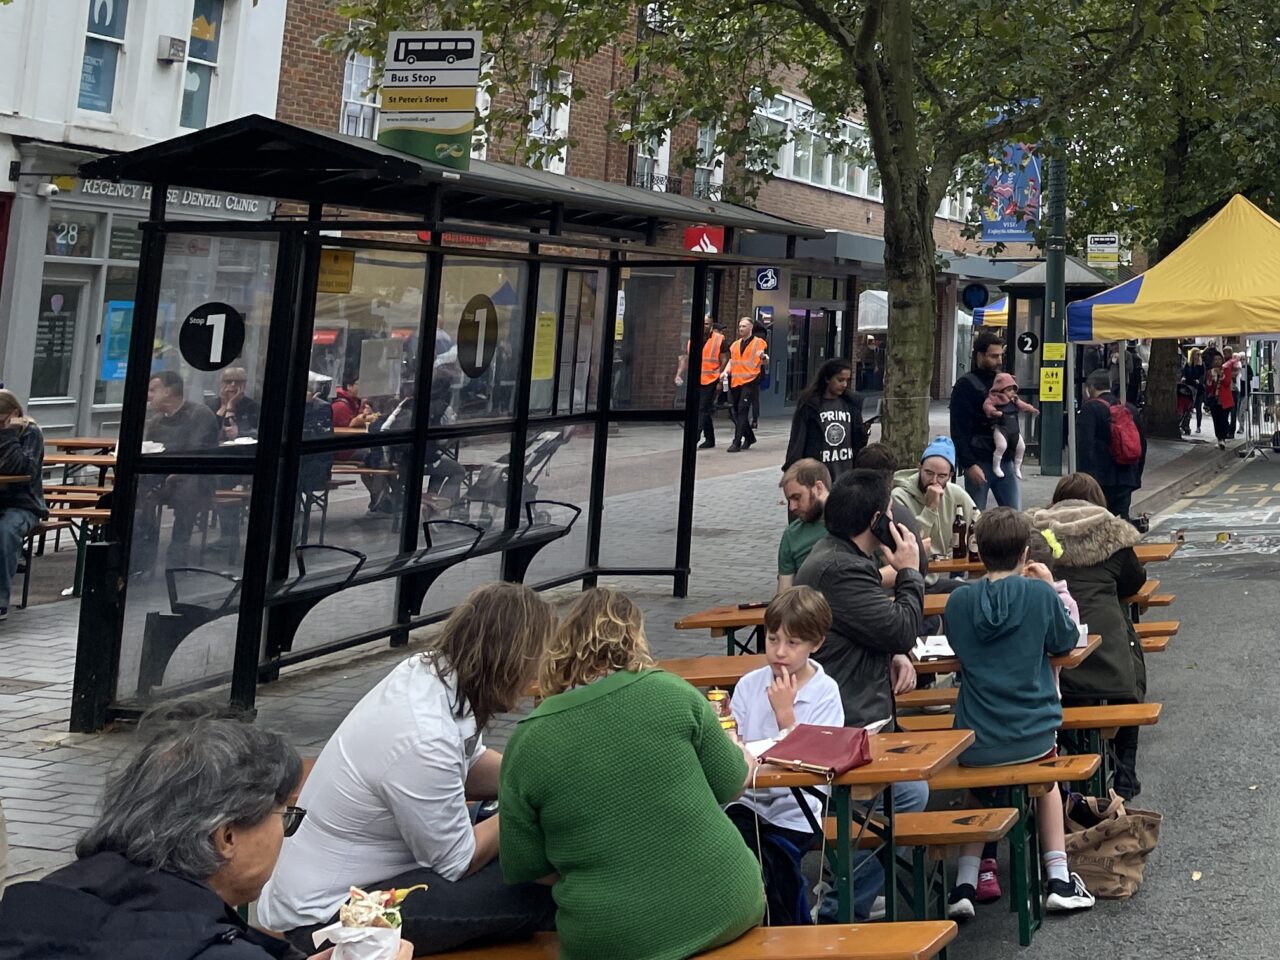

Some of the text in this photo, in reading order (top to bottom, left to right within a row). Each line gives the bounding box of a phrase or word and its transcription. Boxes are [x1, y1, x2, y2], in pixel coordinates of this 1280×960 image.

[391, 74, 436, 84] Bus Stop
[83, 178, 259, 212] REGENCY HSE DENTAL CLINIC
[56, 222, 79, 245] 28
[189, 313, 226, 363] Stop 1
[474, 308, 488, 368] 1
[1023, 337, 1033, 351] 2
[821, 447, 854, 463] RACK
